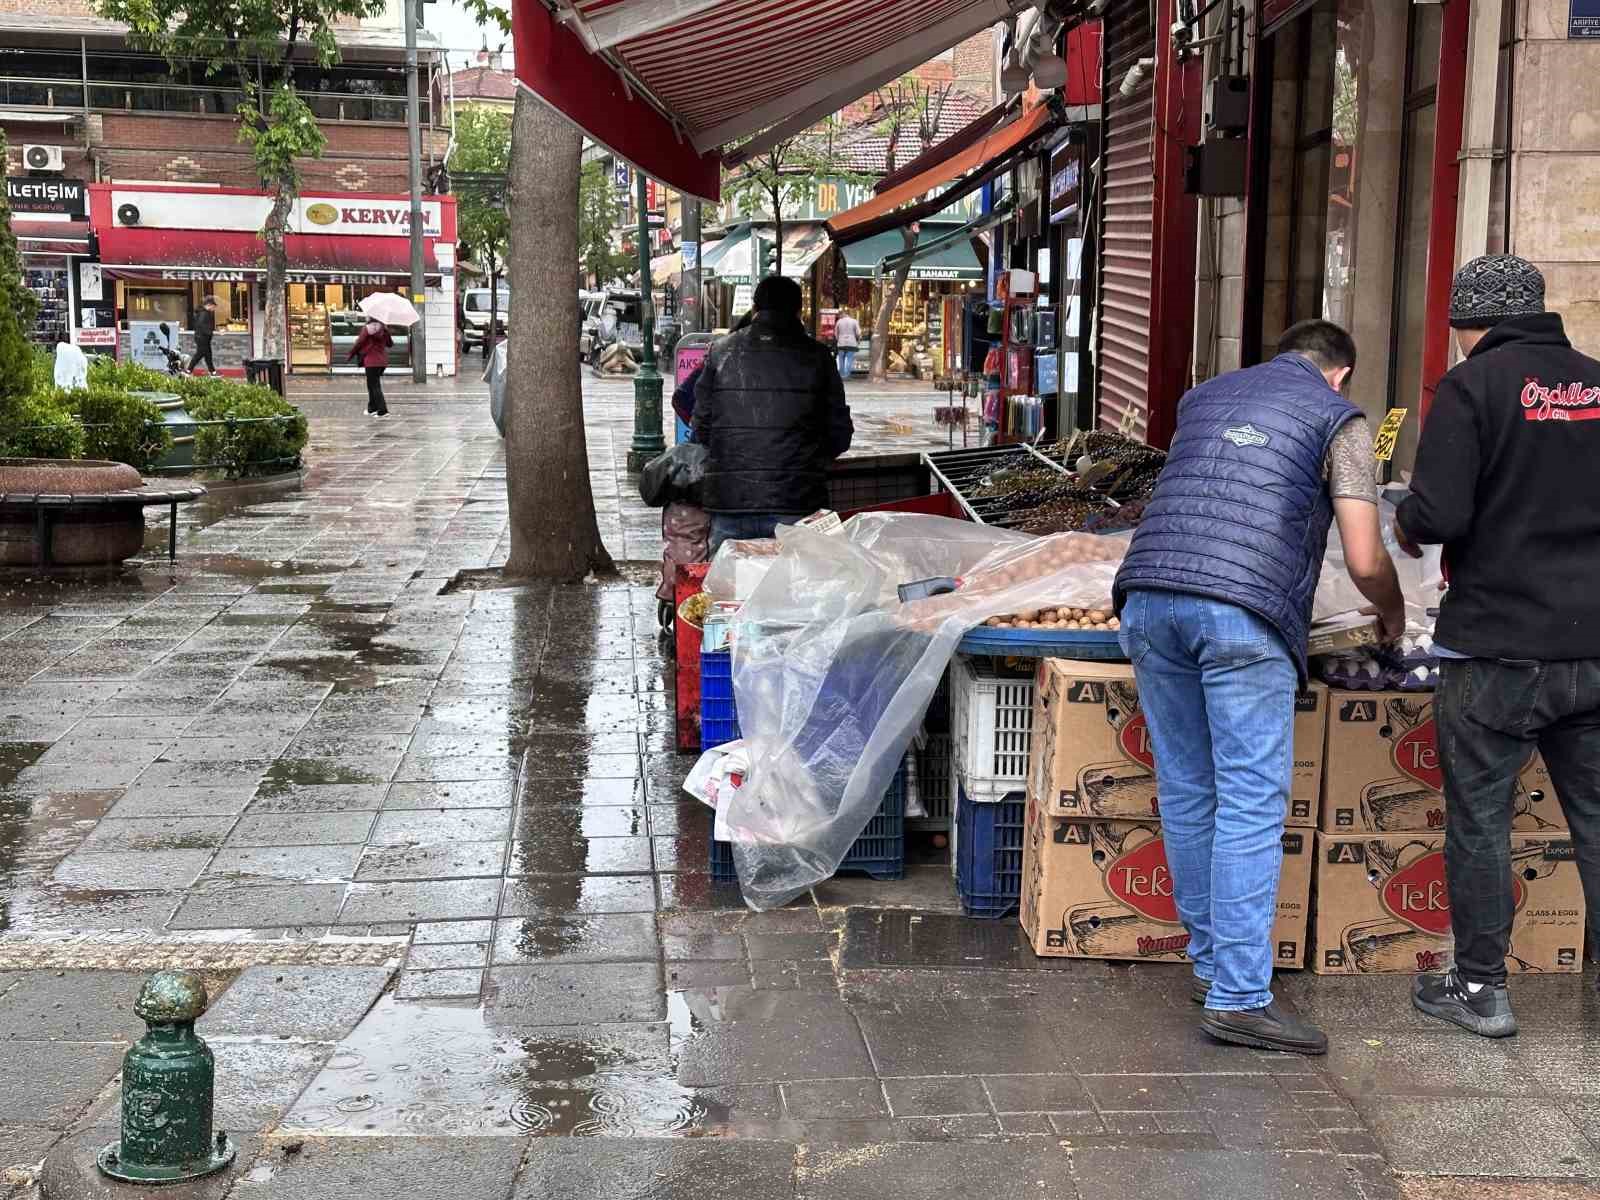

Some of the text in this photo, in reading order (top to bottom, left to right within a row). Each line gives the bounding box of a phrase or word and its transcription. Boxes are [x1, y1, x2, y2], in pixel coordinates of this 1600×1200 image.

[8, 181, 78, 202] İLETİŞİM
[342, 208, 431, 226] KERVAN
[162, 270, 243, 281] KERVAN
[920, 270, 959, 278] BAHARAT
[1545, 847, 1576, 855] EXPORT
[1118, 866, 1176, 896] Tek
[1393, 881, 1451, 911] Tek
